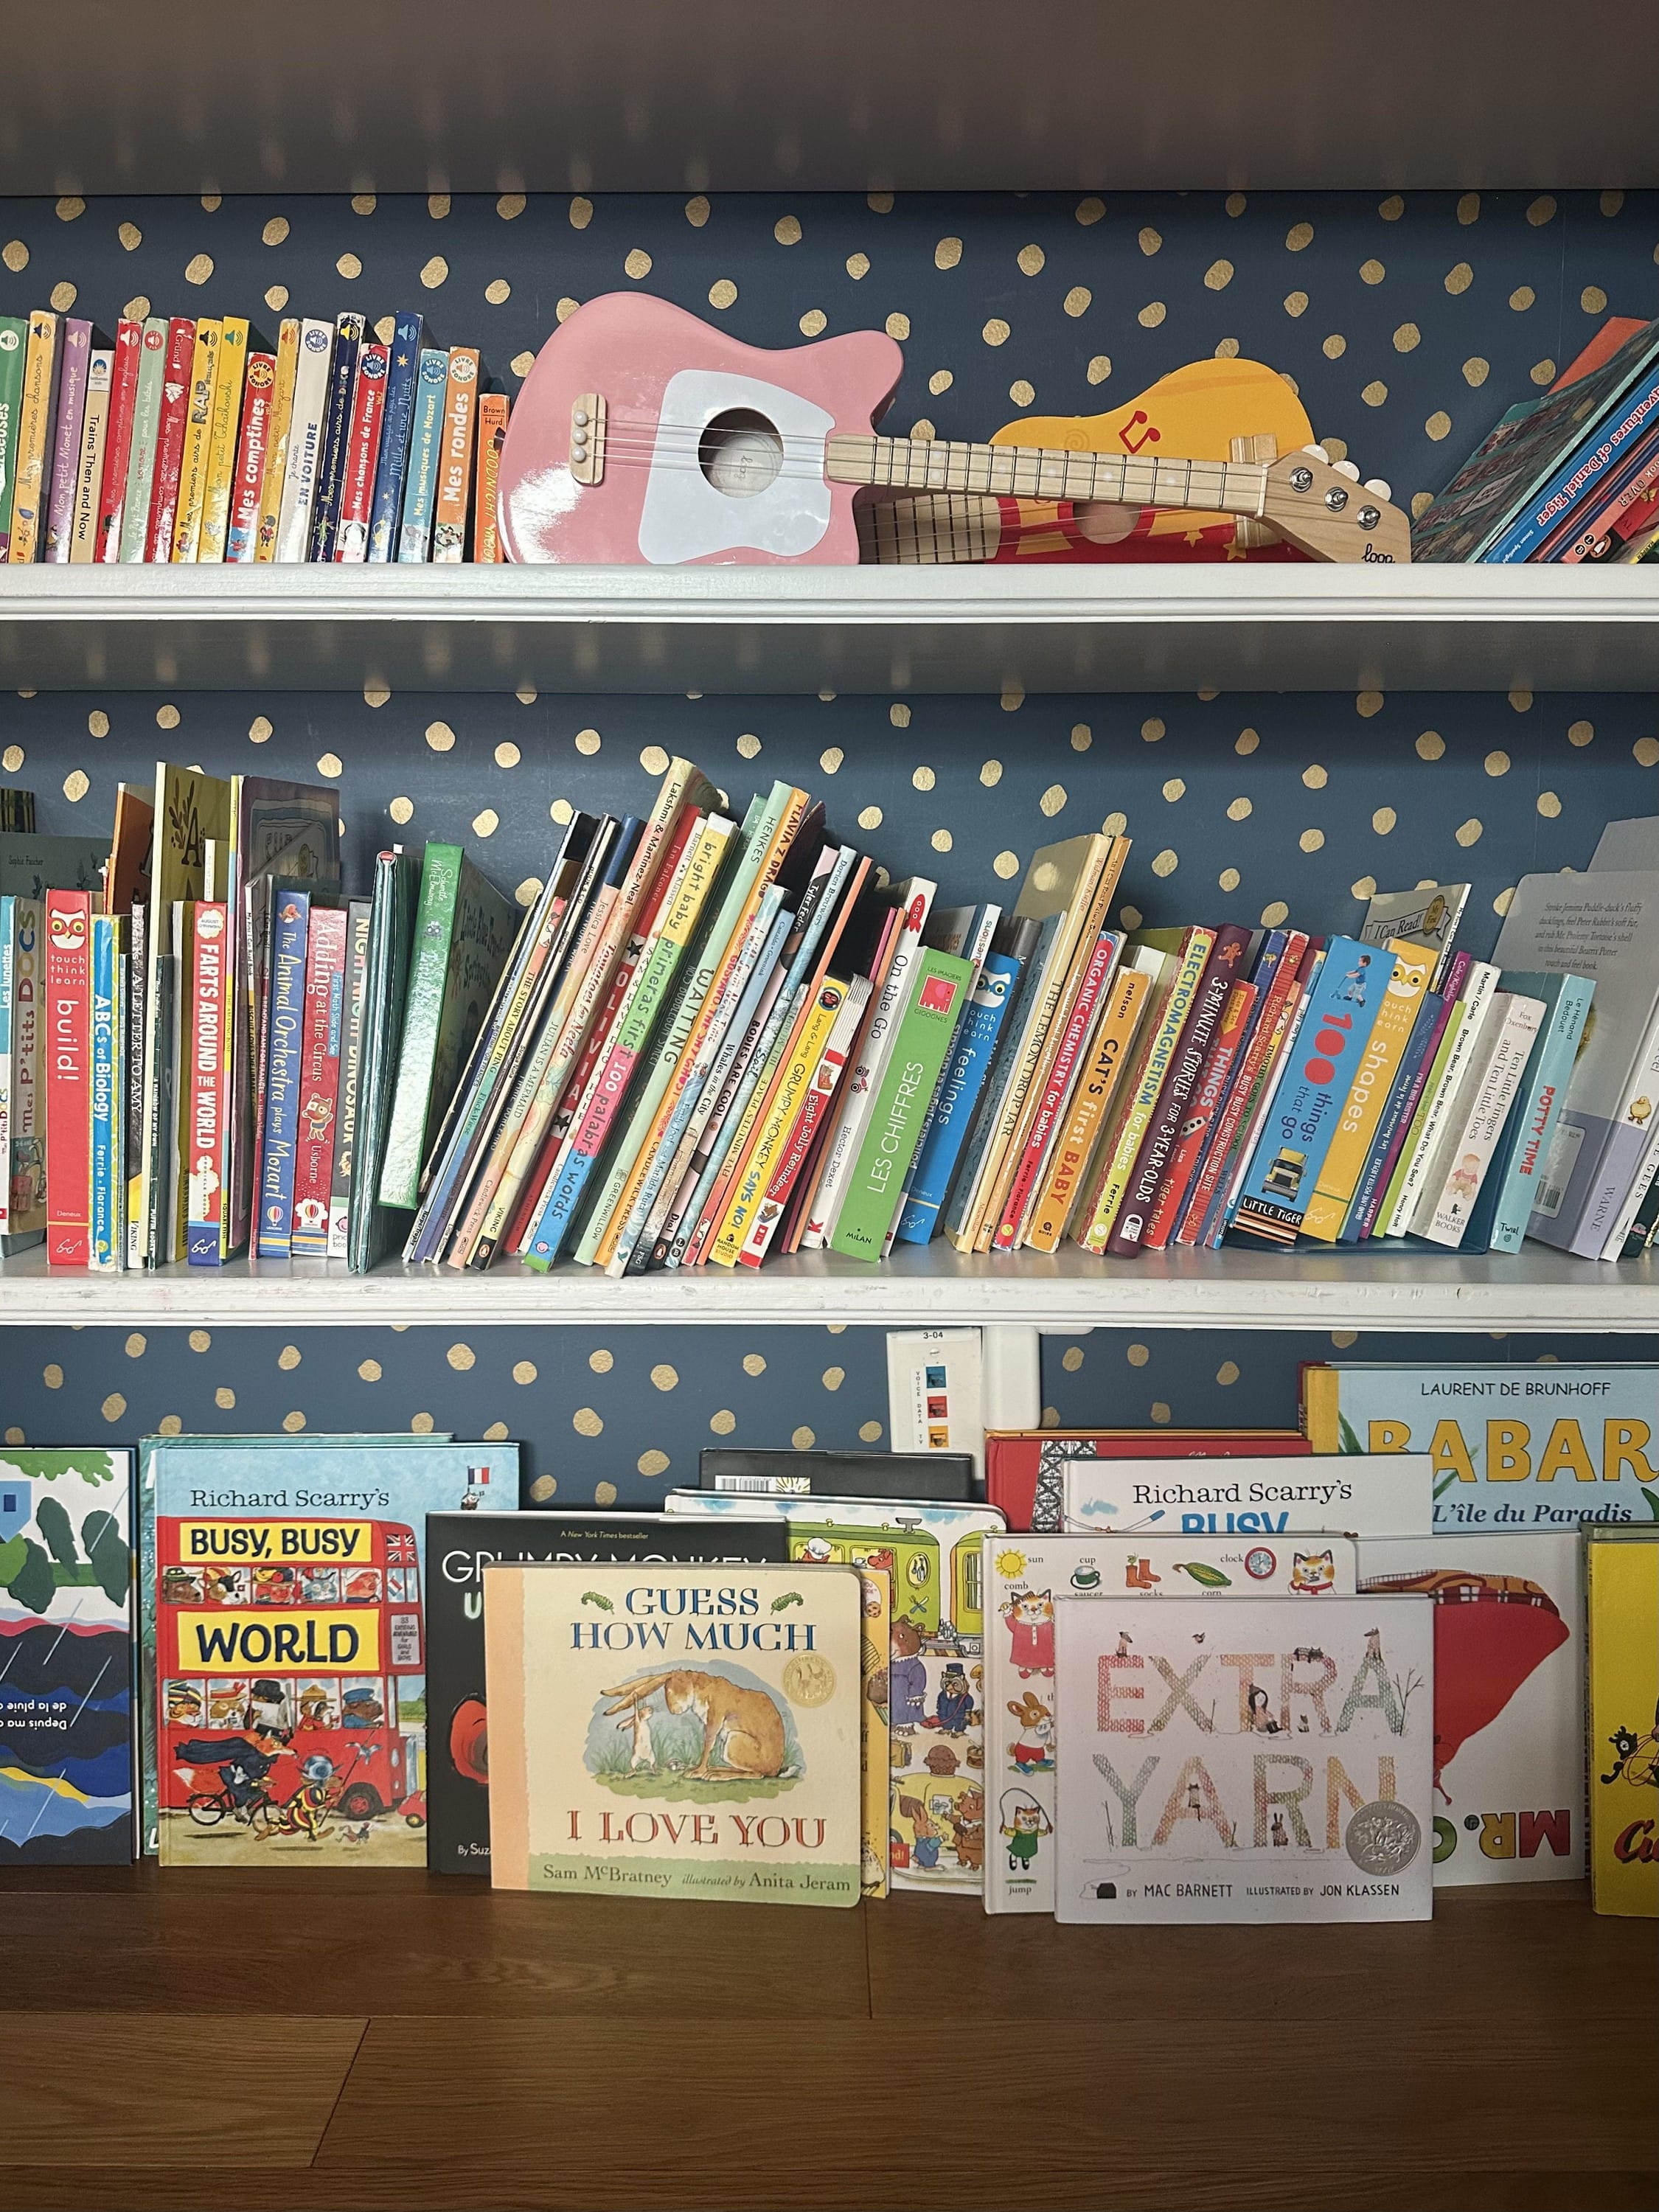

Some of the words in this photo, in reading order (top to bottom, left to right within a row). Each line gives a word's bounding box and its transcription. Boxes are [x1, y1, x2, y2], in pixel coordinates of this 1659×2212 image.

[68, 366, 79, 406] musique
[68, 408, 74, 422] en
[362, 390, 375, 422] France
[426, 395, 436, 428] Mozart
[60, 424, 72, 458] Monet
[88, 414, 100, 451] Trains
[362, 426, 369, 438] de
[425, 432, 431, 444] de
[452, 393, 469, 459] rondes
[85, 453, 97, 482] Then
[237, 489, 254, 521] Mes
[246, 398, 265, 484] comptines
[300, 423, 317, 482] VOITURE
[358, 443, 369, 487] chansons
[1597, 443, 1613, 462] of
[417, 448, 430, 493] musiques
[443, 467, 462, 503] Mes
[1563, 456, 1602, 501] Daniel
[54, 493, 66, 515] Mon
[82, 486, 91, 508] and
[297, 489, 307, 506] EN
[352, 488, 363, 509] Mes
[414, 498, 423, 515] Mes
[1538, 492, 1570, 526] Tiger
[78, 512, 91, 540] Now
[688, 842, 717, 892] bright
[669, 895, 695, 931] baby
[282, 932, 296, 949] The
[51, 966, 85, 974] think
[198, 944, 218, 999] FARTS
[307, 922, 336, 997] Adding
[637, 936, 675, 1014] primeras
[889, 955, 908, 977] On
[51, 975, 85, 985] learn
[276, 953, 302, 1011] Animal
[1078, 950, 1107, 1012] ORGANIC
[313, 1001, 325, 1013] at
[879, 984, 899, 1012] the
[1117, 983, 1135, 1019] nelson
[1192, 977, 1228, 1047] 3-MINUTE
[94, 995, 111, 1043] ABCs
[313, 1016, 327, 1037] the
[664, 968, 715, 1065] WAITING
[871, 1018, 888, 1038] Go
[1138, 942, 1207, 1106] ELECTROMAGNETISM
[56, 1000, 80, 1081] build!
[198, 1002, 218, 1071] AROUND
[619, 1018, 646, 1060] first
[1054, 1015, 1085, 1088] CHEMISTRY
[1304, 1013, 1353, 1085] 100
[97, 1048, 106, 1059] of
[271, 1015, 298, 1101] Orchestra
[311, 1042, 326, 1082] Circus
[1088, 1039, 1119, 1095] CAT'S
[93, 1062, 111, 1122] Biology
[198, 1077, 215, 1086] THE
[605, 1062, 627, 1091] 100
[778, 1063, 805, 1115] GRUMPY
[938, 1048, 976, 1125] feelings
[1342, 1039, 1389, 1133] shapes
[803, 1094, 818, 1121] Eight
[1043, 1090, 1060, 1107] for
[1166, 1102, 1181, 1121] FOR
[1291, 1086, 1310, 1113] that
[1534, 1085, 1556, 1135] POTTY
[197, 1091, 216, 1149] WORLD
[271, 1107, 285, 1133] plays
[574, 1093, 610, 1168] palabras
[867, 1158, 891, 1193] LES
[882, 1062, 924, 1153] CHIFFRES
[1032, 1112, 1054, 1148] babies
[1069, 1101, 1098, 1144] first
[1130, 1111, 1147, 1133] for
[1281, 1116, 1298, 1140] go
[1301, 1092, 1332, 1142] things
[759, 1118, 780, 1169] MONKEY
[794, 1123, 812, 1151] Jolly
[1118, 1133, 1140, 1172] babies
[265, 1139, 291, 1200] Mozart
[1135, 1124, 1175, 1204] 3-YEAR-OLDS
[1520, 1138, 1540, 1175] TIME
[740, 1170, 760, 1202] SAYS
[770, 1151, 802, 1197] Reindeer
[1050, 1151, 1080, 1206] BABY
[552, 1172, 580, 1218] words
[1590, 1185, 1616, 1231] WARNE
[733, 1206, 748, 1229] NO!
[1436, 1220, 1461, 1233] BOOKS
[1437, 1211, 1465, 1226] WALKER
[717, 1238, 740, 1250] RANDOM
[717, 1244, 735, 1253] HOUSE
[924, 1331, 943, 1340] 3-04
[1422, 1383, 1495, 1396] LAURENT
[1500, 1383, 1520, 1396] DE
[1526, 1383, 1611, 1396] BRUNHOFF
[918, 1434, 922, 1444] TV
[1368, 1418, 1659, 1482] BABAR
[190, 1489, 288, 1507] Richard
[296, 1487, 390, 1510] Scarry's
[1133, 1484, 1242, 1504] Richard
[1249, 1481, 1352, 1504] Scarry's
[1494, 1503, 1526, 1523] du
[1533, 1503, 1632, 1522] Paradis
[191, 1528, 271, 1559] BUSY,
[282, 1528, 360, 1555] BUSY
[599, 1531, 616, 1540] Times
[1079, 1556, 1096, 1565] cup
[1220, 1554, 1243, 1563] clock
[626, 1587, 759, 1615] GUESS
[1004, 1582, 1028, 1590] comb
[196, 1621, 359, 1663] WORLD
[571, 1623, 672, 1651] HOW
[685, 1624, 817, 1651] MUCH
[7, 1699, 35, 1713] pluie
[38, 1703, 49, 1712] la
[52, 1703, 67, 1712] de
[1097, 1652, 1405, 1734] EXTRA
[29, 1717, 67, 1731] Depuis
[1092, 1755, 1395, 1849] YARN
[568, 1811, 581, 1840] I
[599, 1812, 719, 1845] LOVE
[728, 1815, 827, 1848] YOU
[1464, 1810, 1571, 1859] MR.
[543, 1864, 577, 1879] Sam
[583, 1865, 671, 1887] McBratney
[683, 1873, 730, 1885] illustrated
[732, 1876, 745, 1888] by
[749, 1873, 794, 1888] Anita
[800, 1875, 850, 1891] Jeram
[1009, 1886, 1032, 1896] jump
[1127, 1888, 1137, 1896] BY
[1144, 1884, 1172, 1896] MAC
[1177, 1884, 1233, 1898] BARNETT
[1246, 1887, 1301, 1896] ILLUSTRATED
[1304, 1887, 1313, 1896] BY
[1320, 1884, 1341, 1896] JON
[1346, 1884, 1399, 1896] KLASSEN
